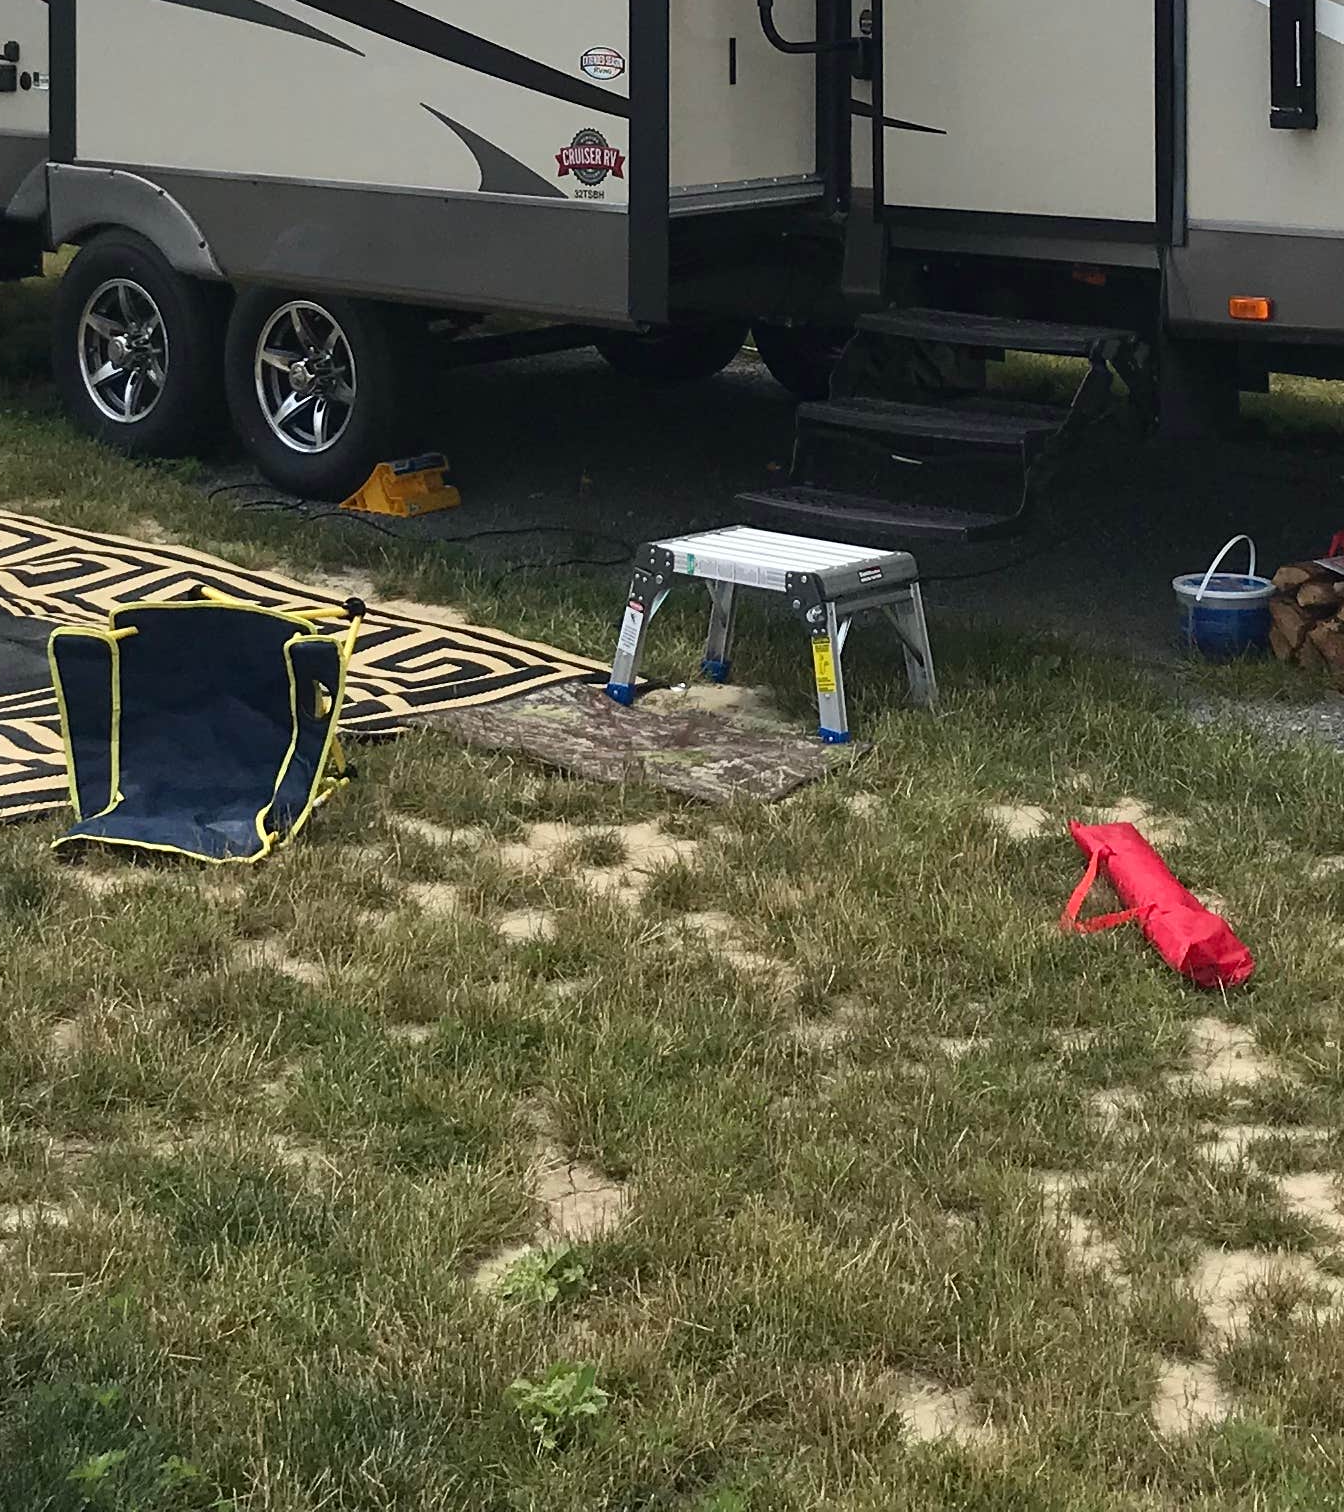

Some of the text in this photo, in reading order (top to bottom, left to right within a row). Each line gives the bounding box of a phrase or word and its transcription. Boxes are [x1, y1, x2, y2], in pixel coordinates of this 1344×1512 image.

[562, 147, 617, 167] CRUISER RV
[574, 189, 605, 199] 32TSBH
